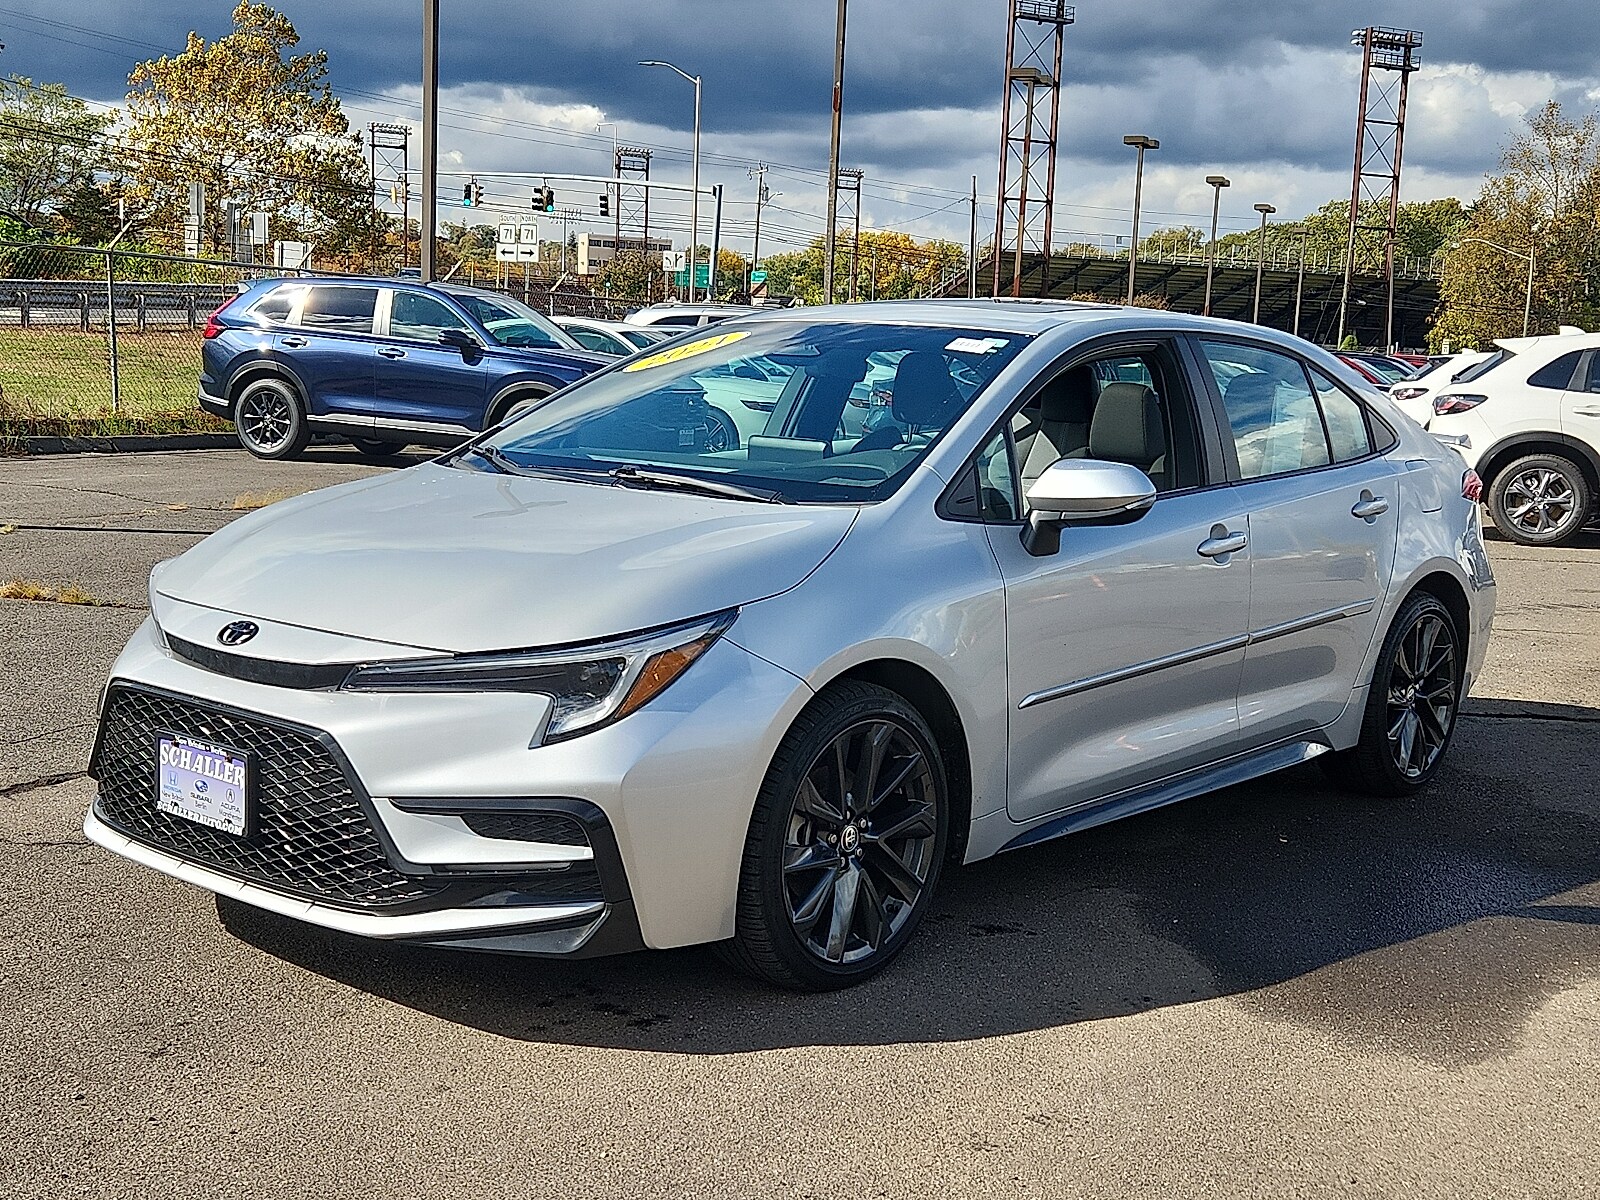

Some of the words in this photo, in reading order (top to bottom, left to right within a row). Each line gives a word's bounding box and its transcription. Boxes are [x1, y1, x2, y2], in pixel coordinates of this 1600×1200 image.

[185, 229, 196, 240] 71
[503, 228, 513, 240] 71
[524, 228, 534, 240] 71
[160, 743, 245, 790] SCHALLER
[163, 784, 182, 793] HONDA
[190, 792, 213, 804] SUBARU
[220, 802, 241, 813] ACURA
